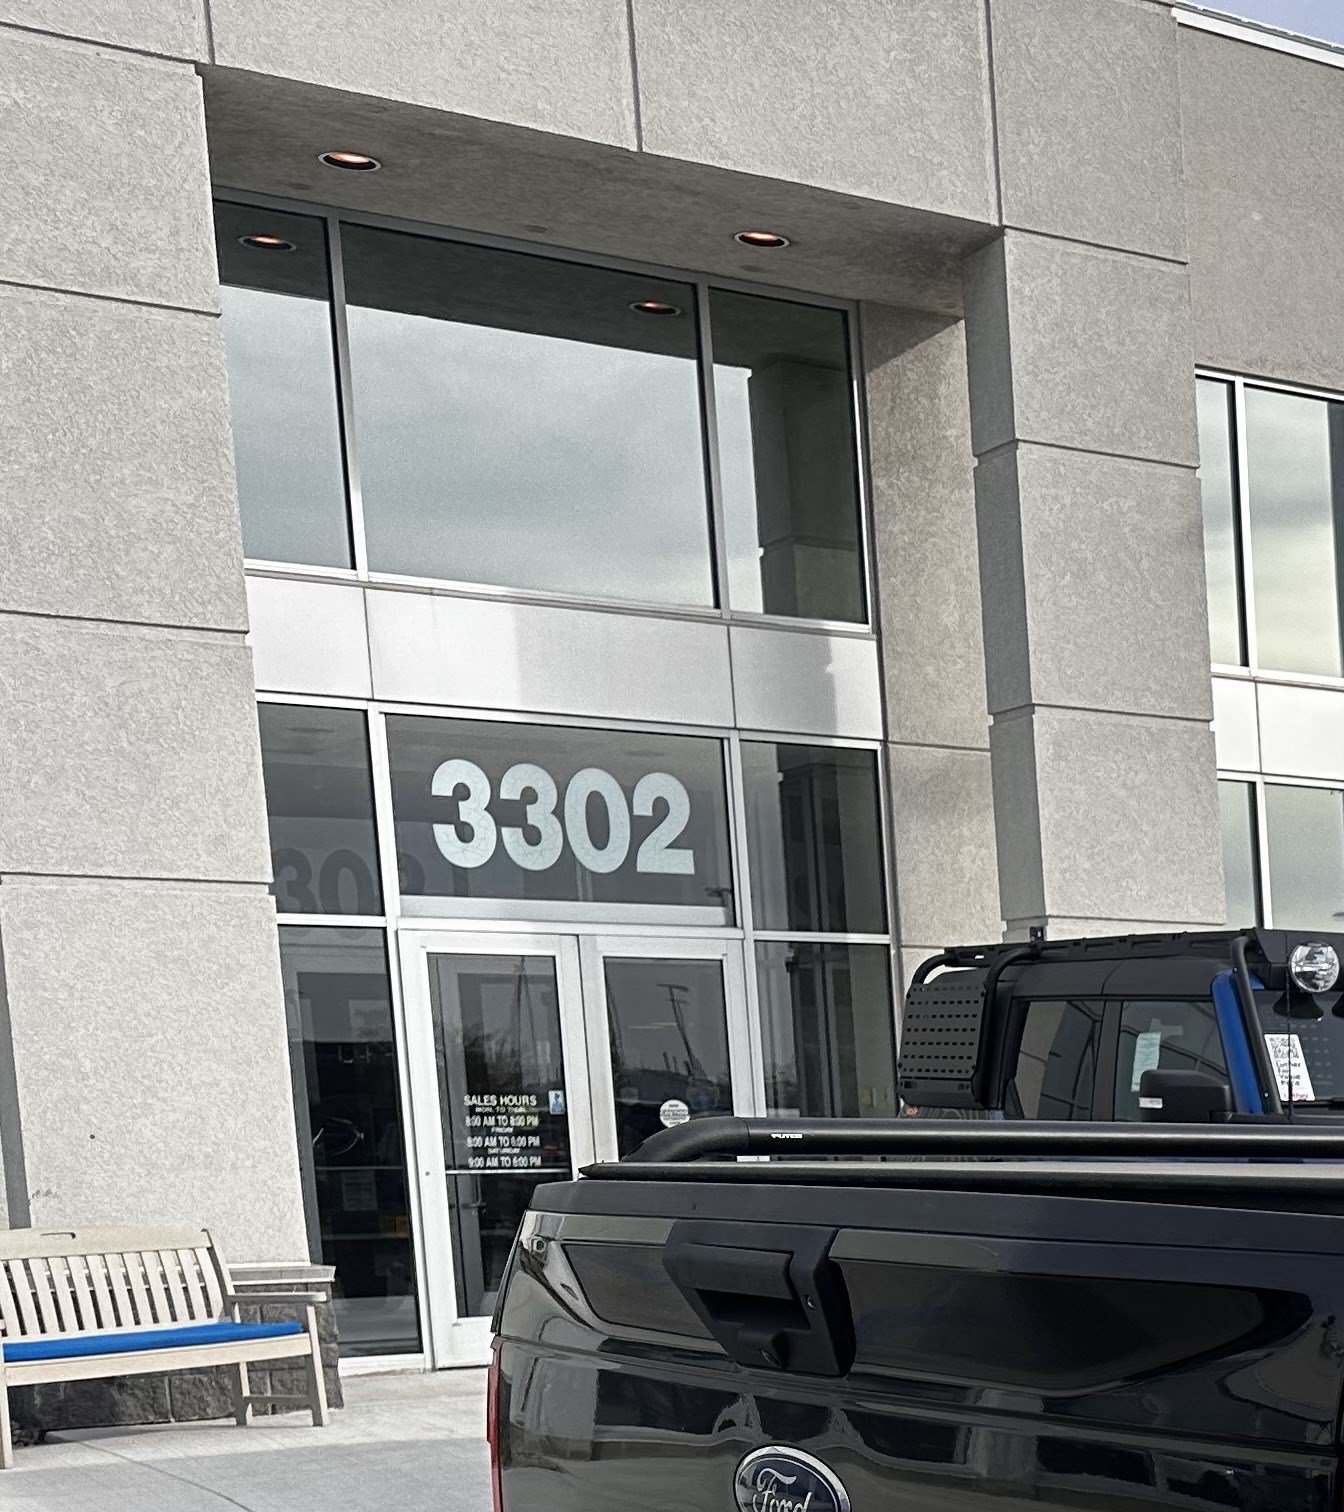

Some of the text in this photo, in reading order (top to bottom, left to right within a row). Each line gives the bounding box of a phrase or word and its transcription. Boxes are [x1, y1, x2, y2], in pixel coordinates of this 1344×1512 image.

[431, 758, 695, 874] 3302
[463, 1094, 538, 1107] SALES HOURS
[483, 1115, 495, 1127] AM
[497, 1115, 508, 1127] TO
[527, 1115, 539, 1127] PM
[484, 1136, 497, 1147] AM
[499, 1136, 509, 1147] TO
[528, 1136, 540, 1147] PM
[486, 1156, 498, 1168] AM
[501, 1156, 511, 1168] TO
[530, 1156, 541, 1168] PM
